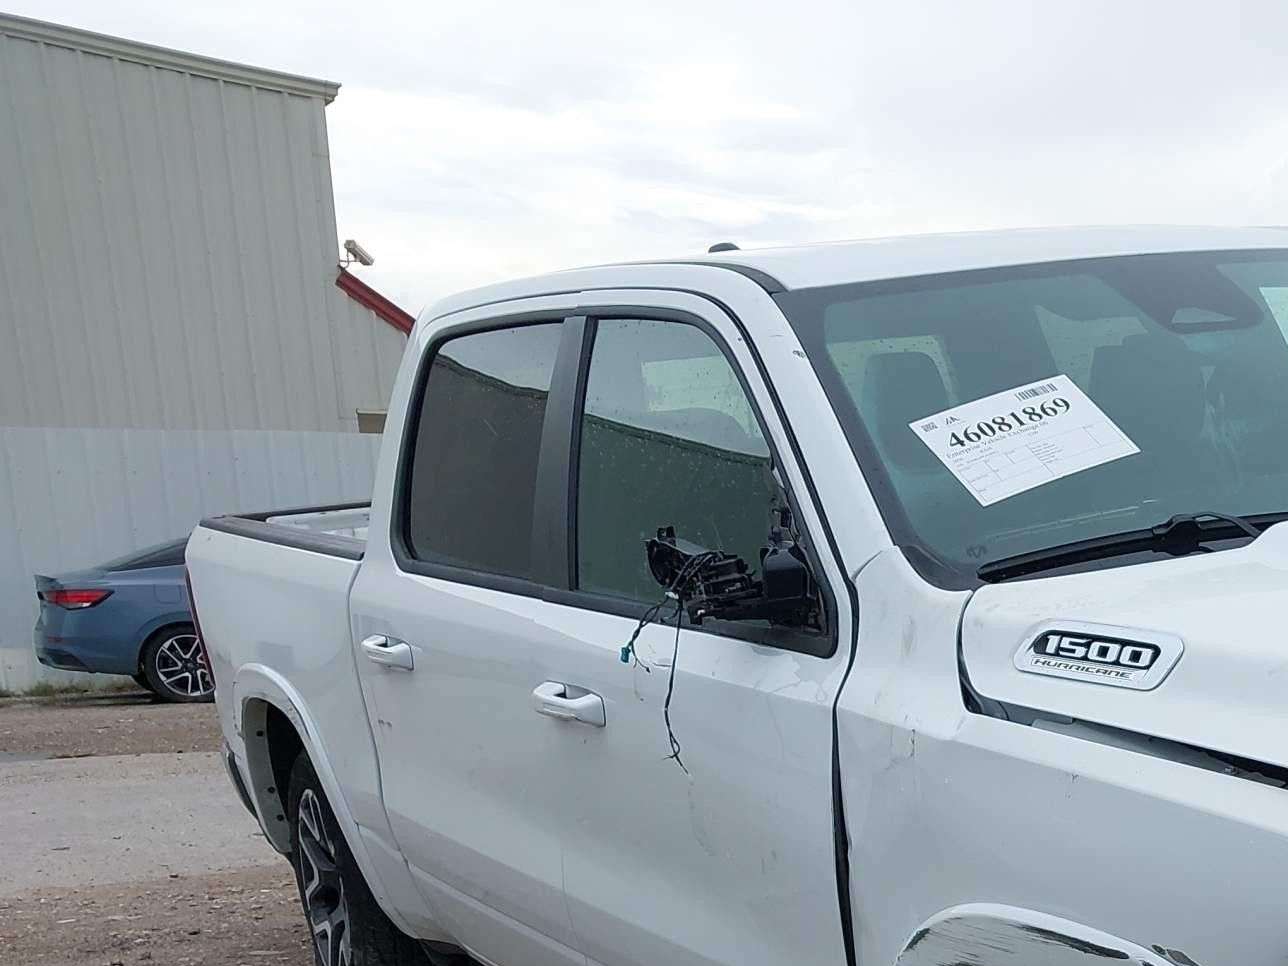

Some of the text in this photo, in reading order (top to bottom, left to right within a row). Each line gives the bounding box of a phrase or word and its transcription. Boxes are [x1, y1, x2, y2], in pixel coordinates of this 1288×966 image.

[949, 397, 1071, 449] 46081869
[1045, 635, 1154, 667] 1500
[1034, 658, 1132, 679] HURRICANE
